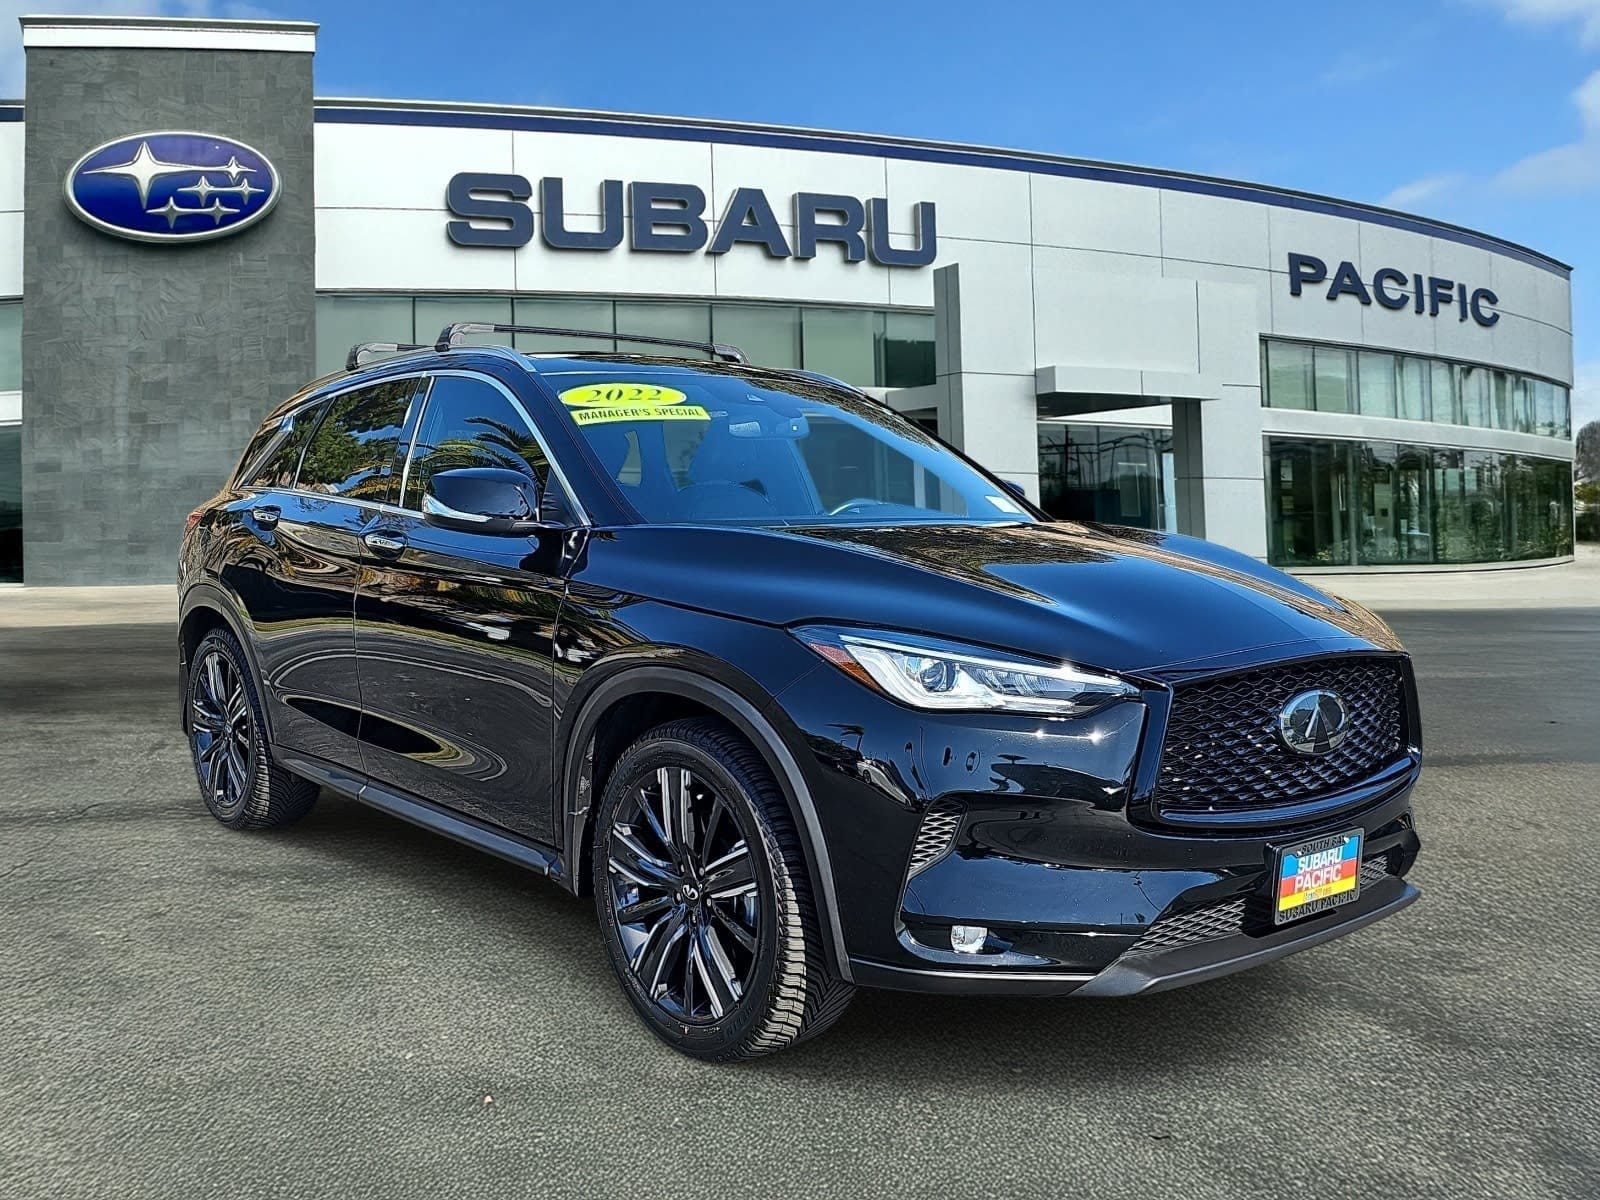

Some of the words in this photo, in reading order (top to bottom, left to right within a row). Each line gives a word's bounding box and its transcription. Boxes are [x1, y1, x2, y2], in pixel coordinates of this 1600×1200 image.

[446, 172, 937, 267] SUBARU
[1287, 252, 1500, 327] PACIFIC
[586, 389, 662, 403] 2022
[578, 407, 651, 421] MANAGER'S
[654, 407, 702, 417] SPECIAL
[1297, 845, 1343, 874] SUBARU
[1301, 838, 1330, 855] SOUTH
[1294, 865, 1342, 894] PACIFIC
[1278, 901, 1318, 923] SUBARU
[1320, 889, 1356, 910] PACIFIC
